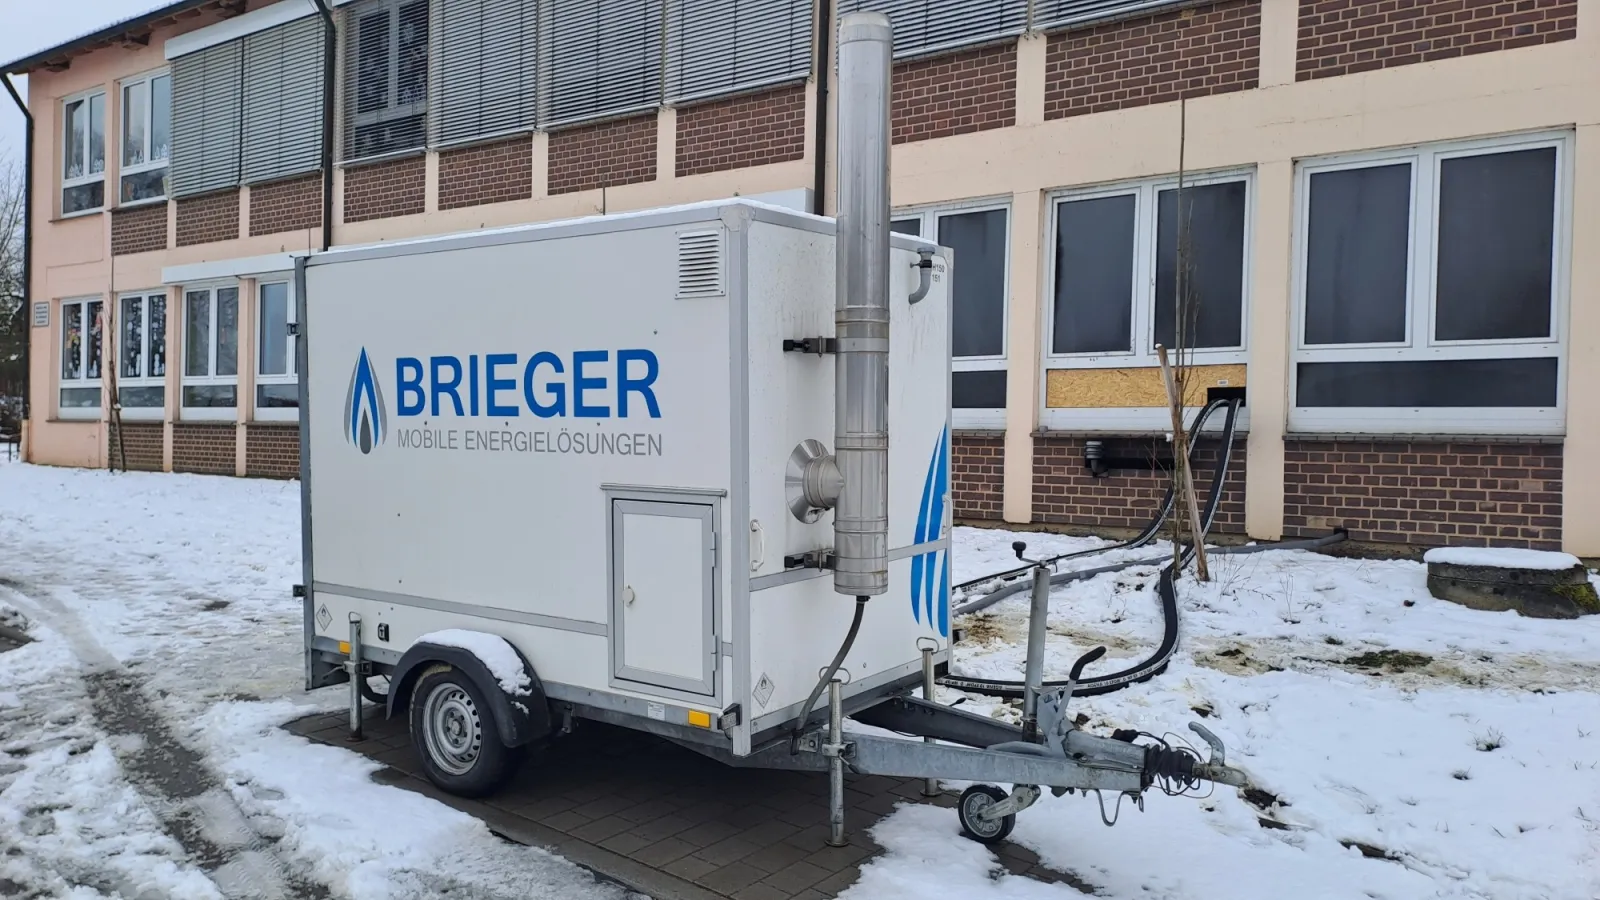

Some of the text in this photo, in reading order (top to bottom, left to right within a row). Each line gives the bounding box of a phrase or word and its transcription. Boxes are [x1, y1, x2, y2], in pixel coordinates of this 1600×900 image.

[396, 349, 662, 419] BRIEGER
[397, 428, 662, 456] MOBILE ENERGIELÖSUNGEN
